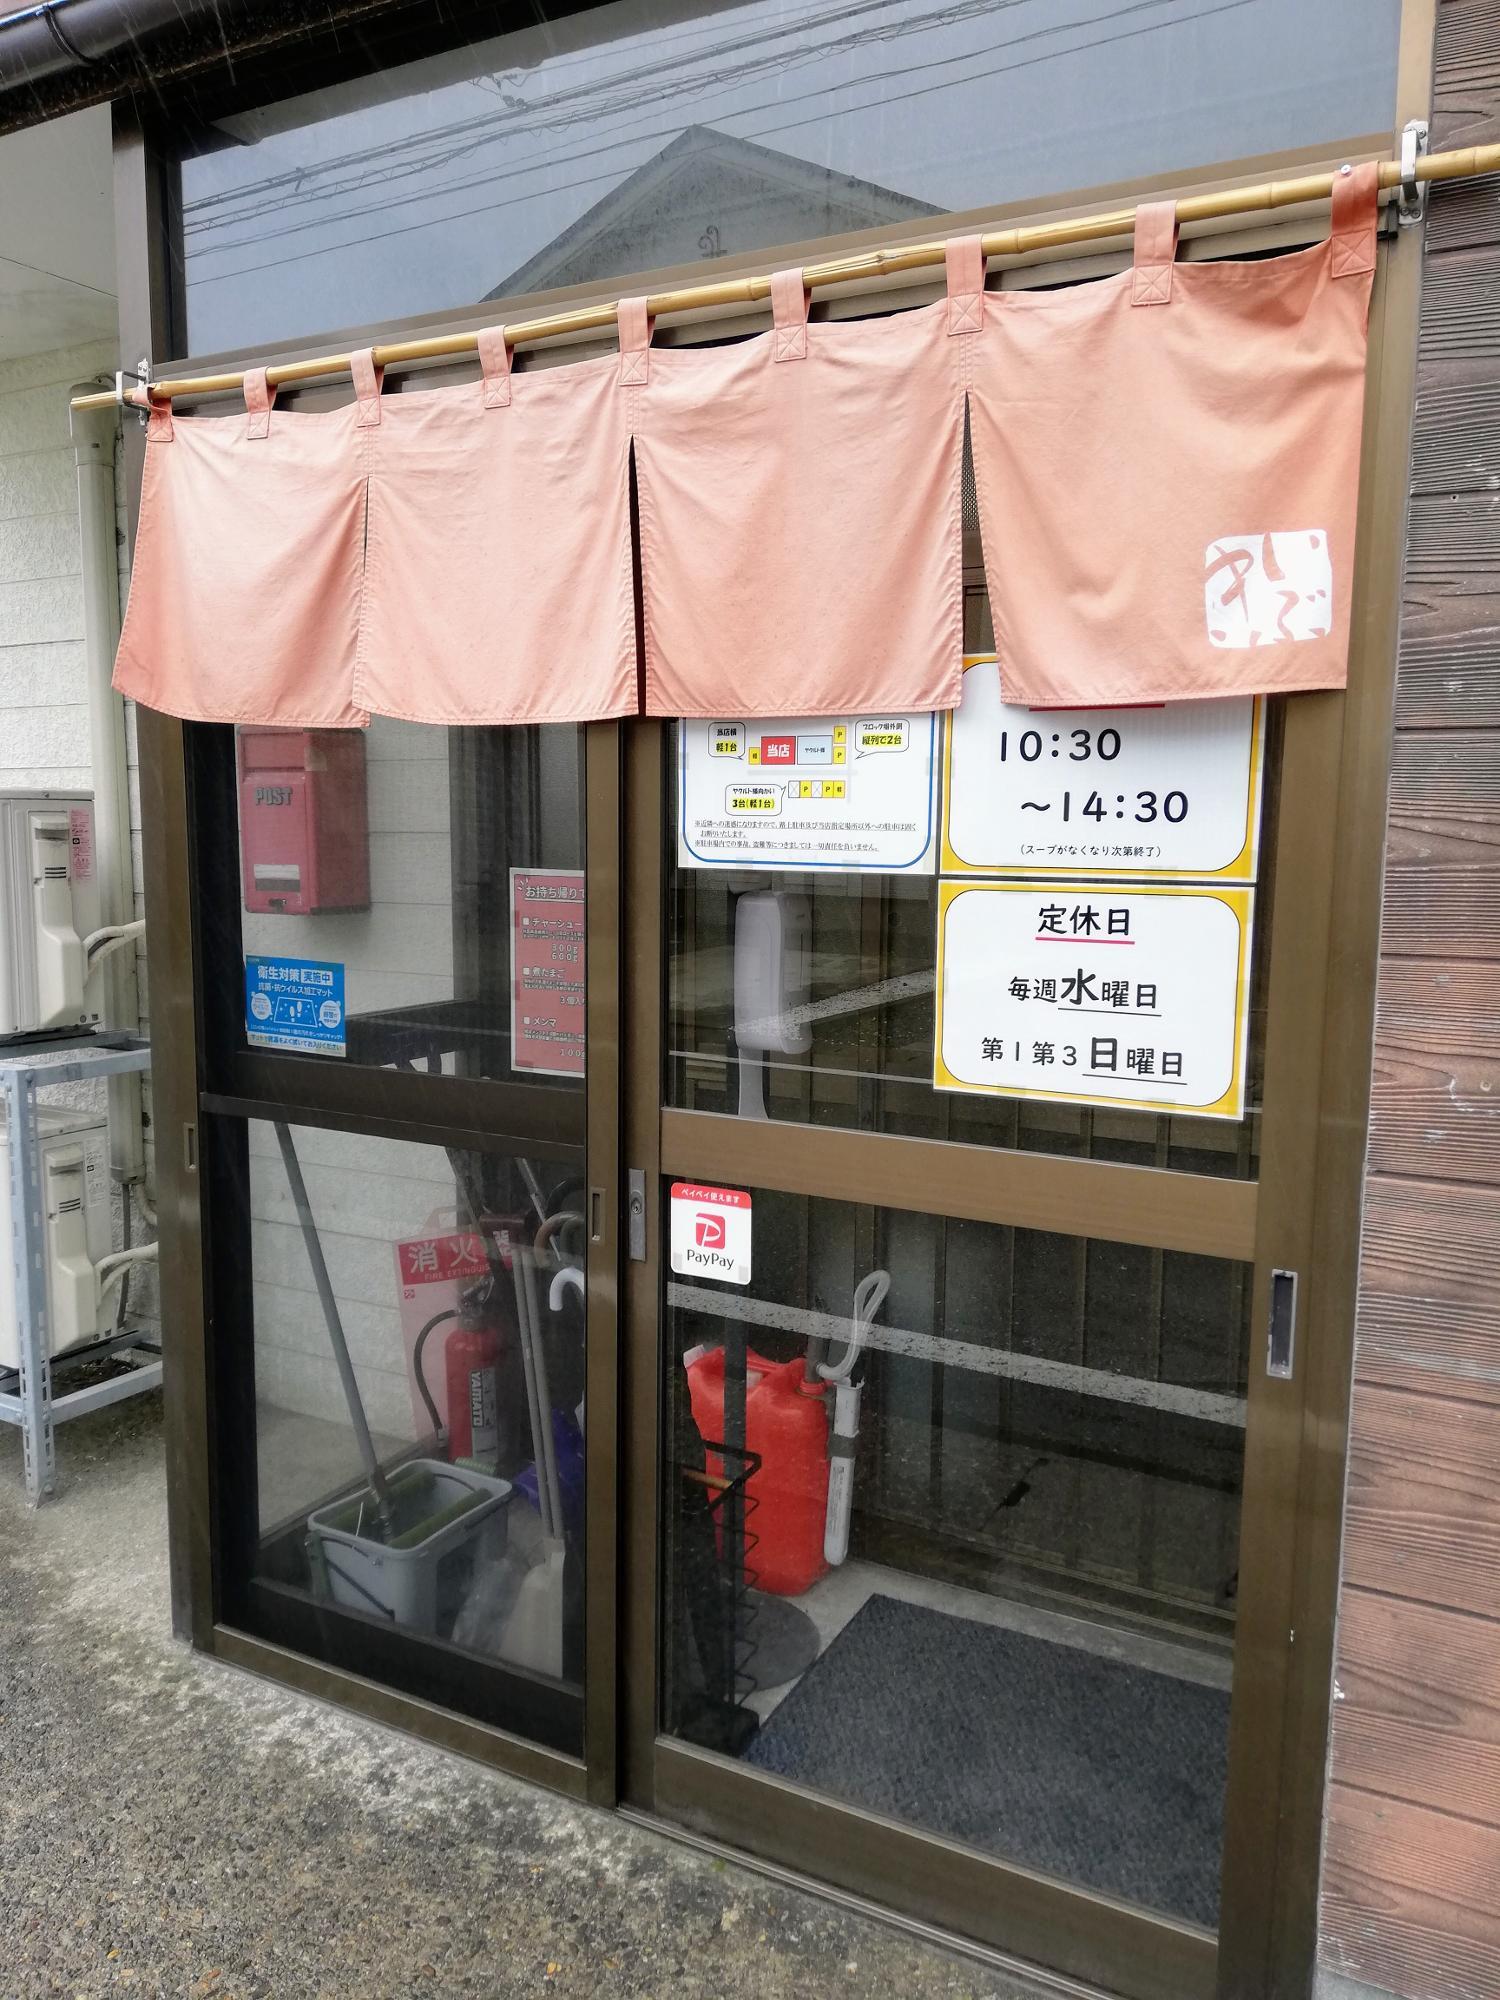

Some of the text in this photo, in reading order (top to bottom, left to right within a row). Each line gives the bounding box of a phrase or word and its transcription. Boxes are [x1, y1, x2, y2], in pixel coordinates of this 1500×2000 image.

[716, 742, 737, 752] 軽1台
[862, 735, 902, 745] 縦列で2台
[1001, 729, 1121, 762] 10:30
[767, 744, 790, 757] 当店
[254, 786, 293, 806] POST
[532, 917, 582, 929] チャーシュー
[1038, 904, 1131, 936] 定休日
[258, 965, 331, 984] 衛生対策 実施中
[1008, 968, 1158, 1009] 毎週水曜日
[560, 996, 584, 1005] 3個入
[533, 1017, 557, 1027] メンマ
[681, 1188, 740, 1203] ペイペイ使えます
[687, 1249, 735, 1270] PayPay
[424, 1271, 443, 1281] FIRE
